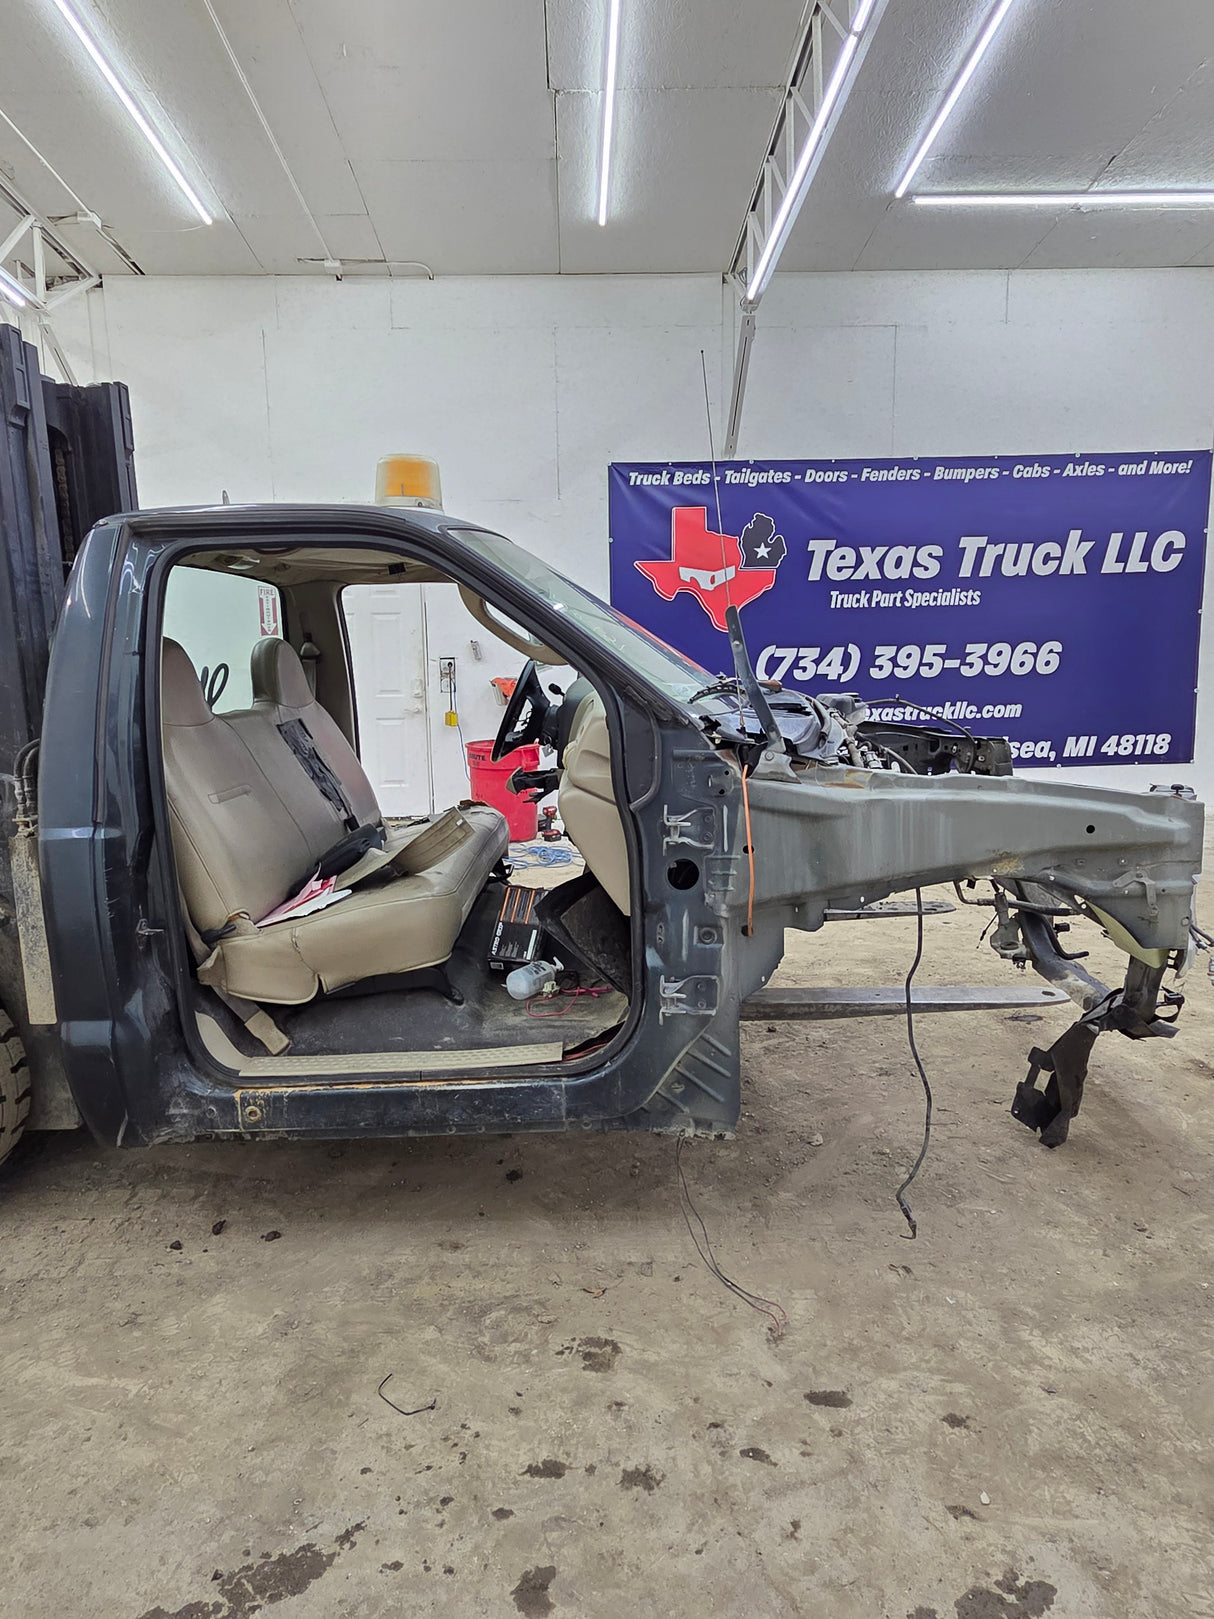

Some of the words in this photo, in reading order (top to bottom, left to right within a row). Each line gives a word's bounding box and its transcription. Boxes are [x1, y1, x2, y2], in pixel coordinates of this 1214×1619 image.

[628, 470, 671, 486] Truck
[672, 469, 710, 485] Beds
[724, 467, 792, 487] Tailgates
[804, 468, 849, 483] Doors
[860, 466, 921, 482] Fenders
[933, 465, 999, 482] Bumpers
[1012, 462, 1051, 478] Cabs
[1062, 461, 1105, 477] Axles
[1117, 460, 1147, 476] and
[1148, 459, 1193, 475] More!
[807, 539, 943, 582] Texas
[958, 529, 1095, 577] Truck
[1100, 530, 1187, 574] LLC
[260, 588, 274, 596] FIRE
[830, 590, 869, 608] Truck
[870, 589, 904, 608] Part
[905, 588, 982, 609] Specialists
[756, 644, 861, 682] (734)
[869, 640, 1063, 680] 395-3966
[1002, 735, 1057, 762] sea,
[1062, 736, 1097, 758] MI
[1100, 733, 1171, 756] 48118
